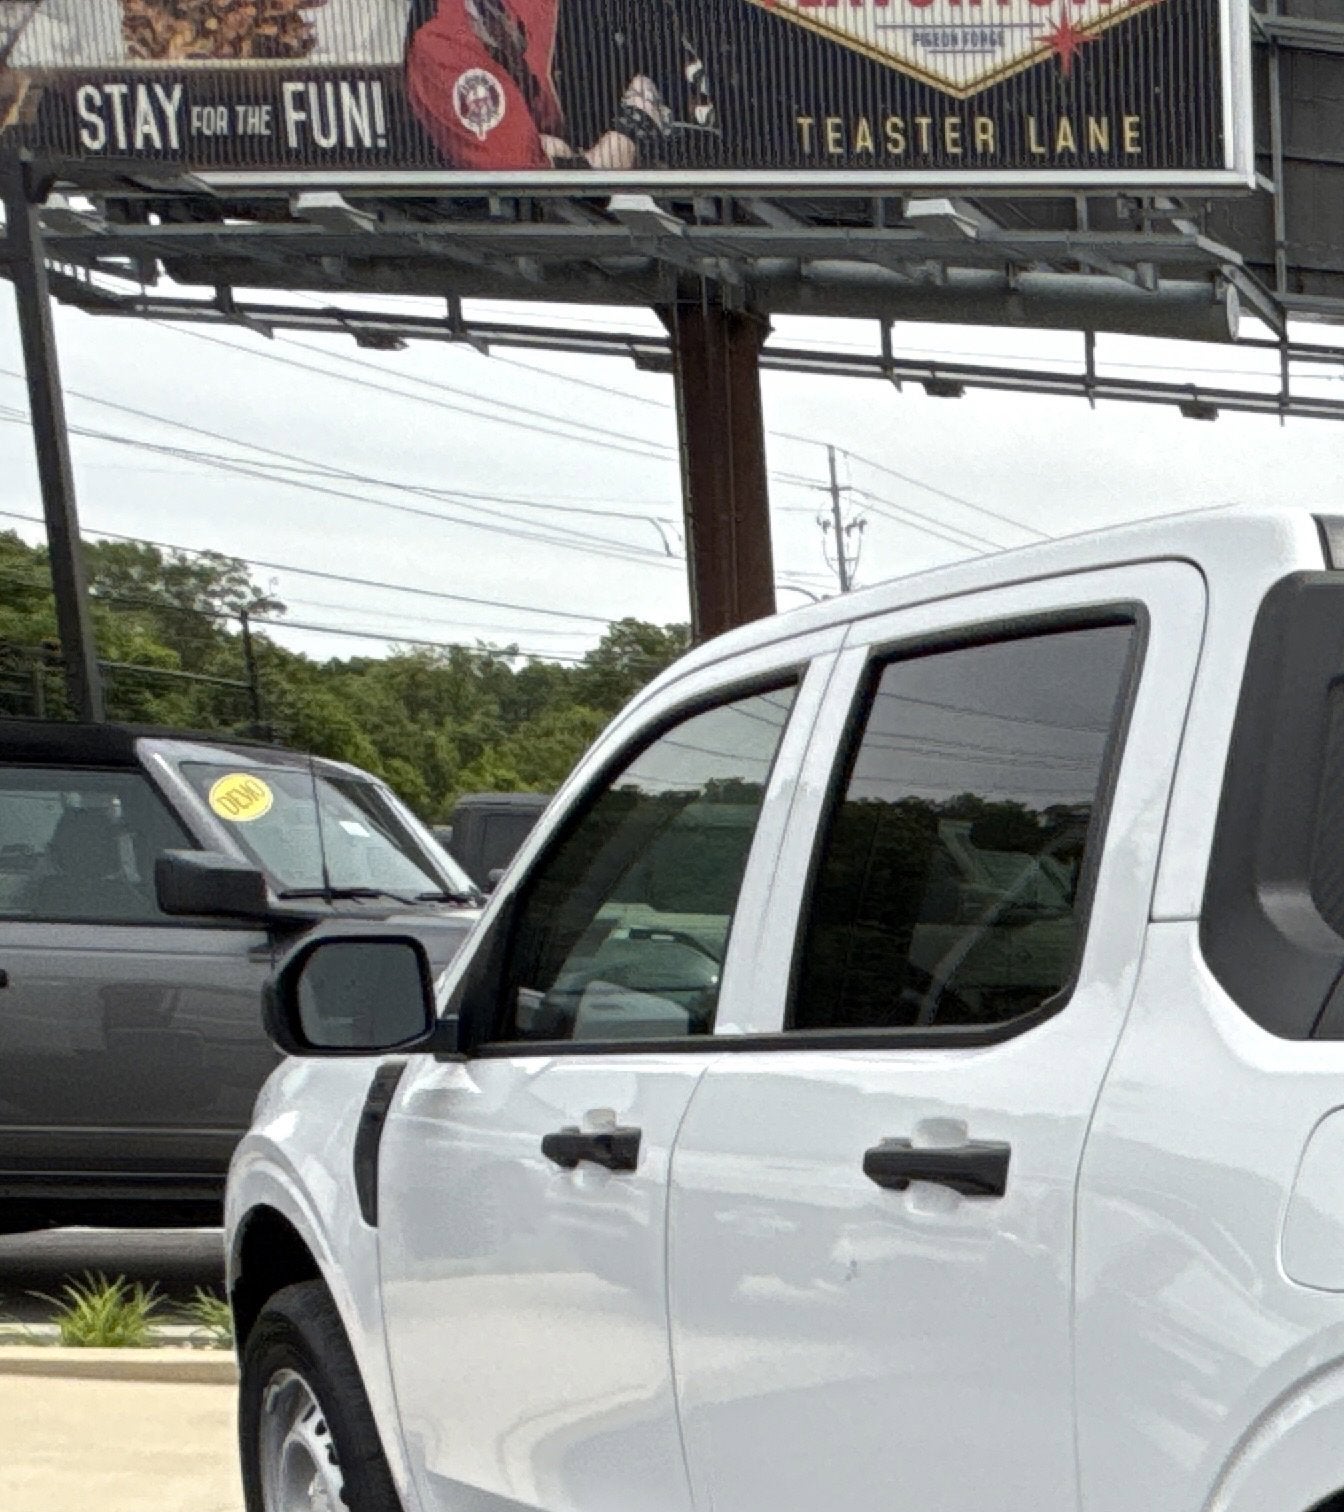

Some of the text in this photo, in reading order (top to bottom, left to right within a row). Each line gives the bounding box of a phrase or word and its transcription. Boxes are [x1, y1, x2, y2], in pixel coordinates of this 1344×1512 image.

[76, 80, 388, 150] STAY FOR THE FUN!
[796, 115, 1143, 154] TEASTER LANE
[215, 780, 266, 816] DEMO
